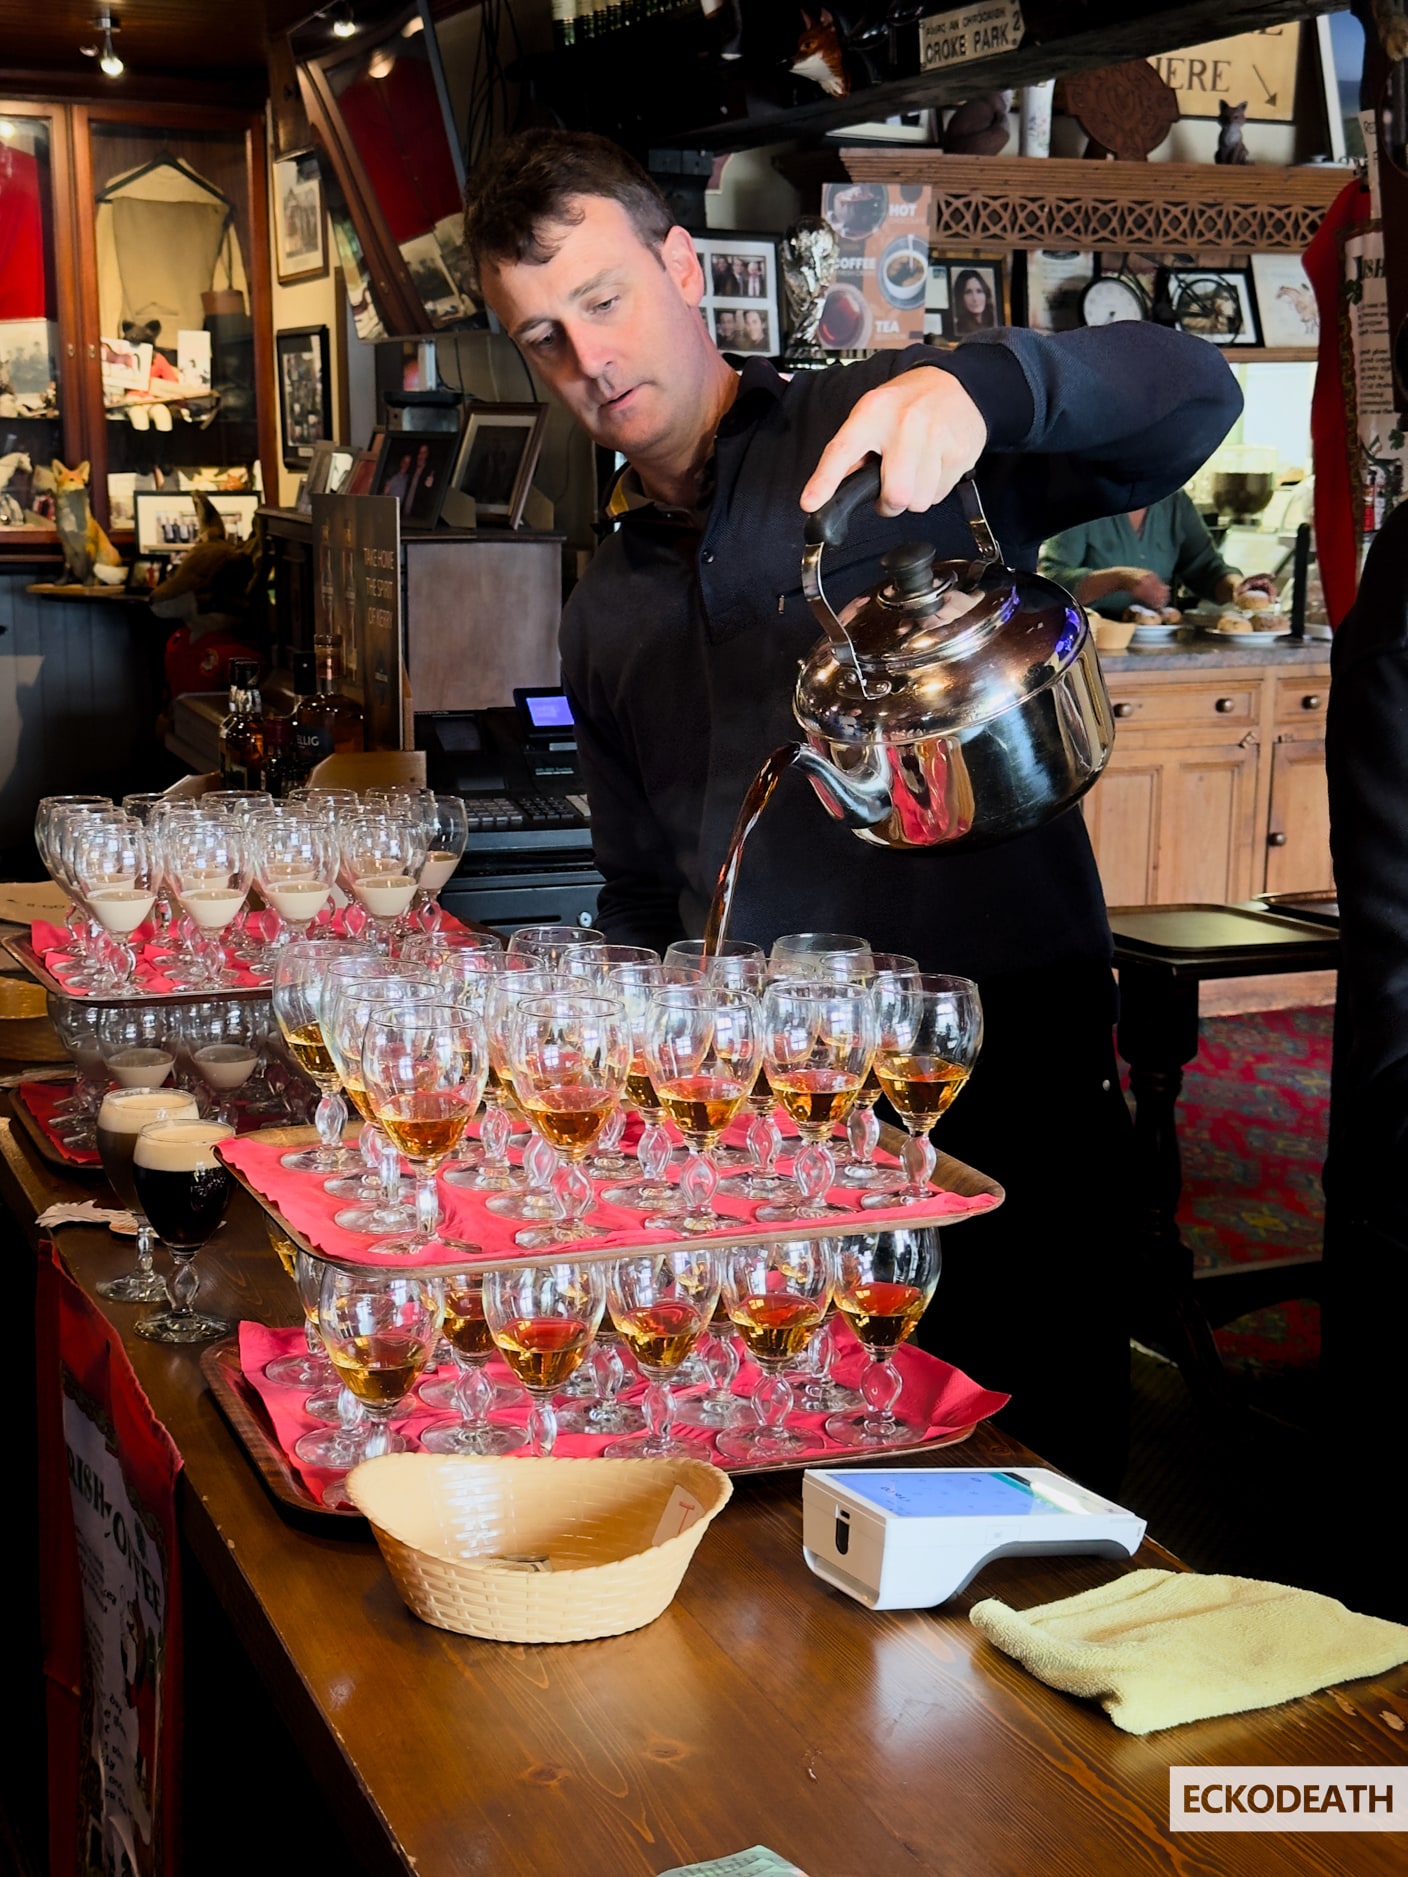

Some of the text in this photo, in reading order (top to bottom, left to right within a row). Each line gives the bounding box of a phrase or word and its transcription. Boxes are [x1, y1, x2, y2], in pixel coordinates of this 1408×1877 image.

[1012, 10, 1020, 31] 2
[926, 22, 1009, 63] CROKE PARK
[889, 204, 917, 217] HOT
[875, 320, 899, 333] TEA
[363, 548, 395, 570] TAKE HOME
[366, 577, 393, 599] THE SPIRIT
[368, 606, 393, 629] OF KERRY
